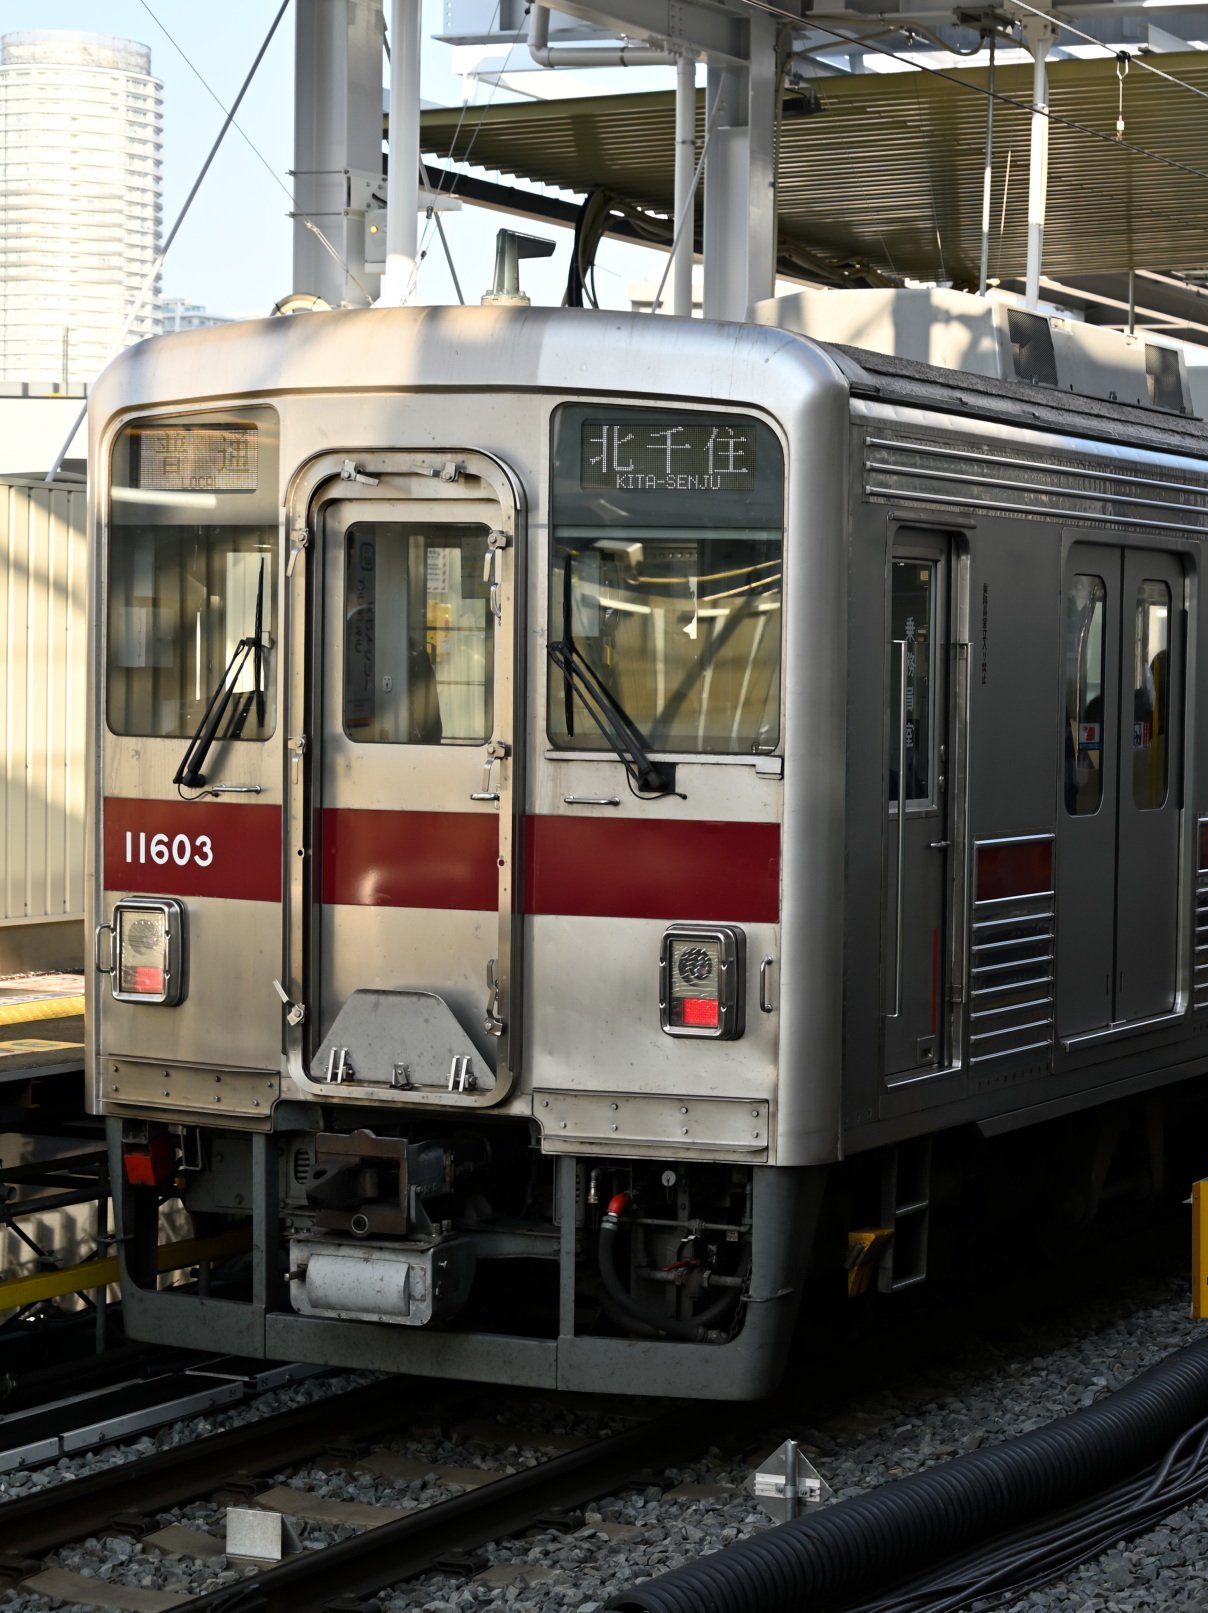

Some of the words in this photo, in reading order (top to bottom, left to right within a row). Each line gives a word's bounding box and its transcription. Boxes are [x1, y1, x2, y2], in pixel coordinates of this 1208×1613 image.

[156, 431, 250, 475] 普通
[589, 425, 748, 474] 北千住
[616, 474, 721, 489] KITA-SENJU
[125, 831, 214, 867] 11603
